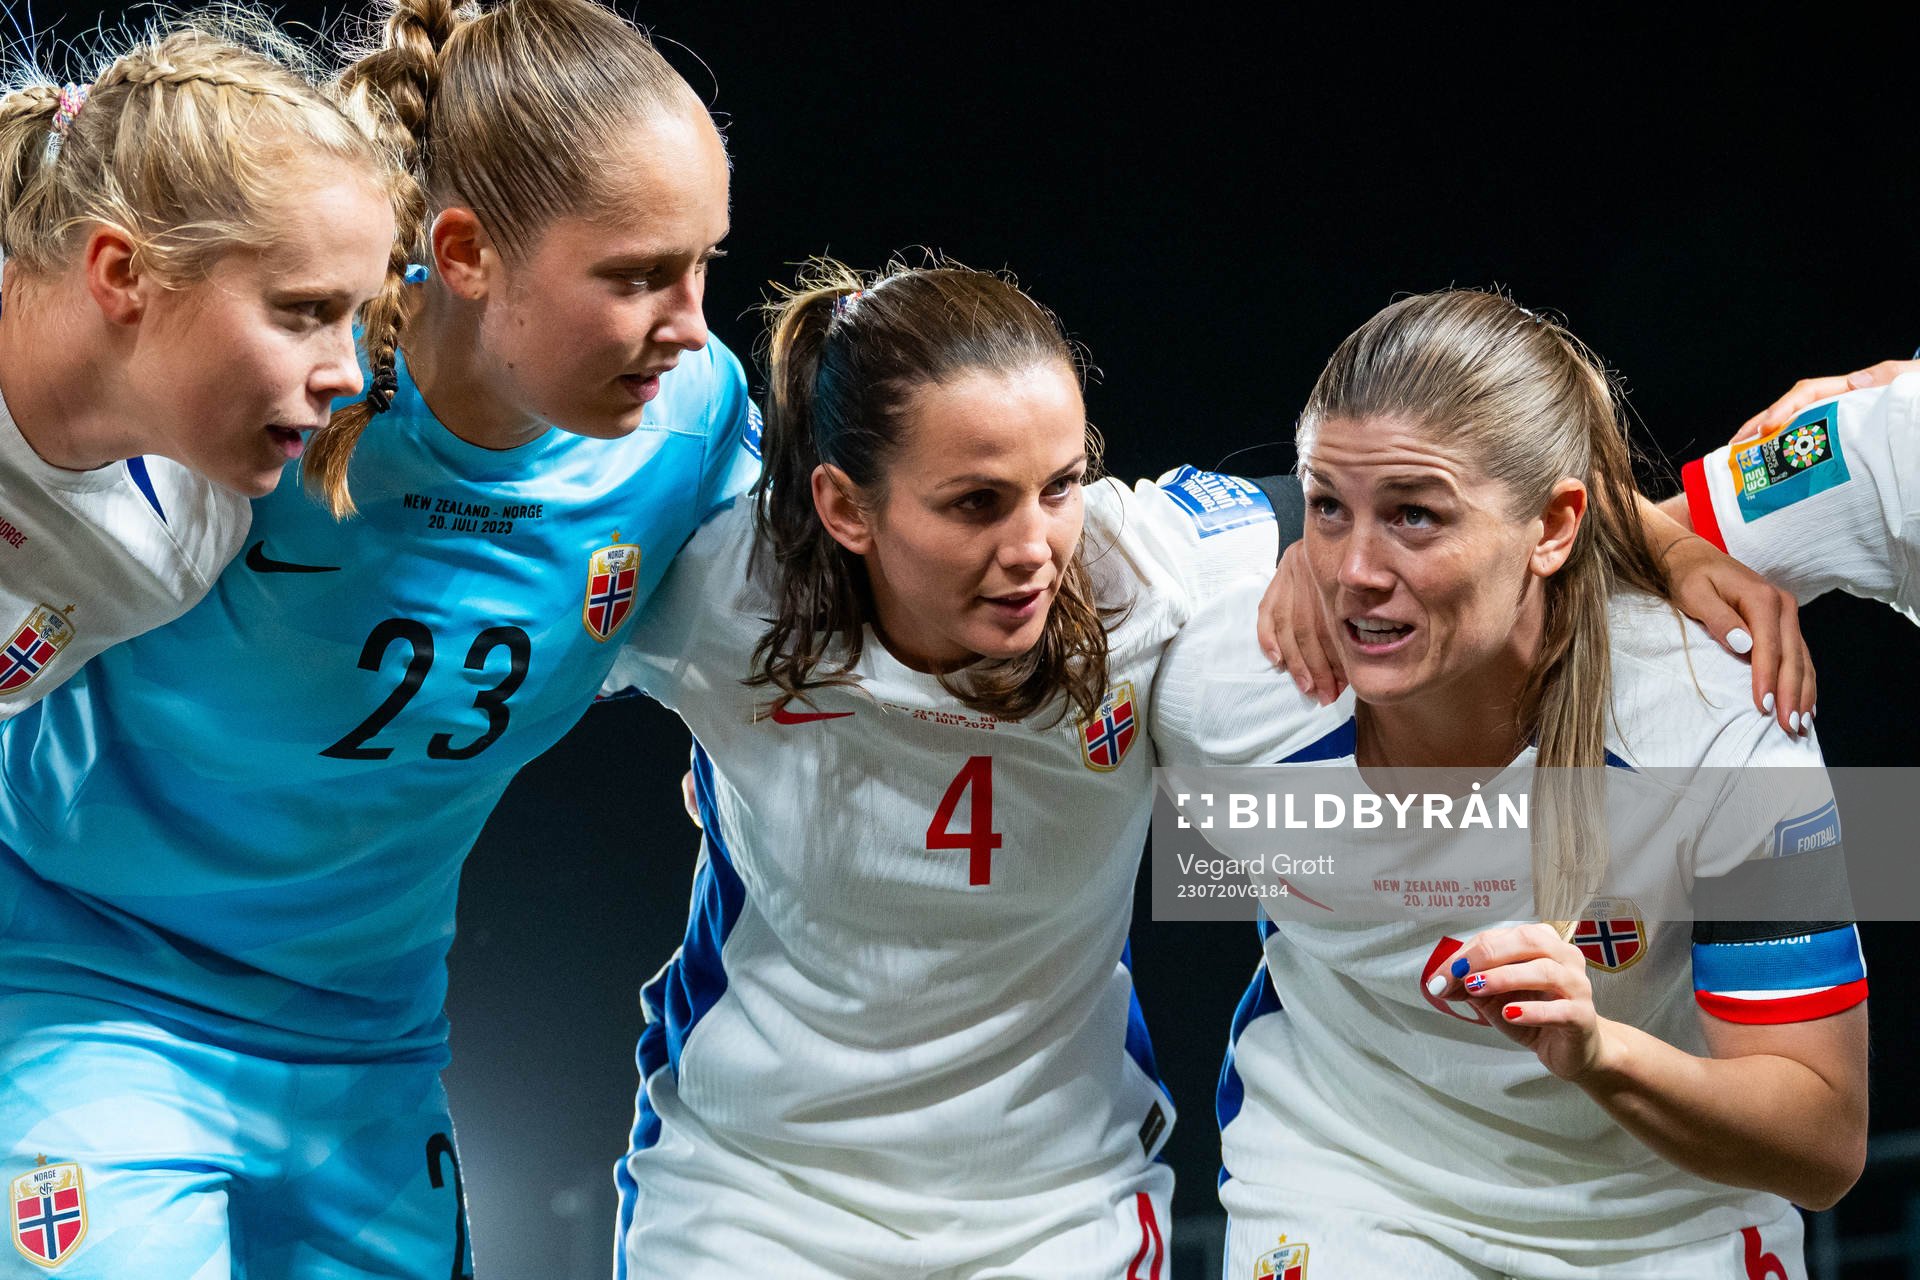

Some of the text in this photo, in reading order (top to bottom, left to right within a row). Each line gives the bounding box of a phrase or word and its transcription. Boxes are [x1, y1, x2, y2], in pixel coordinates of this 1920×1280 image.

[404, 493, 432, 511] NEW
[435, 498, 491, 518] ZEALAND
[502, 504, 543, 519] NORGE
[428, 514, 513, 535] 20. JULI 2023
[608, 549, 624, 560] NORGE
[318, 618, 531, 760] 23
[926, 756, 1002, 886] 4
[1797, 824, 1836, 854] FOOTBALL
[1374, 880, 1400, 892] NEW
[1404, 880, 1460, 893] ZEALAND
[1473, 879, 1518, 892] NORGE
[1403, 894, 1490, 907] 20. JULI 2023
[34, 1169, 57, 1183] NORGE
